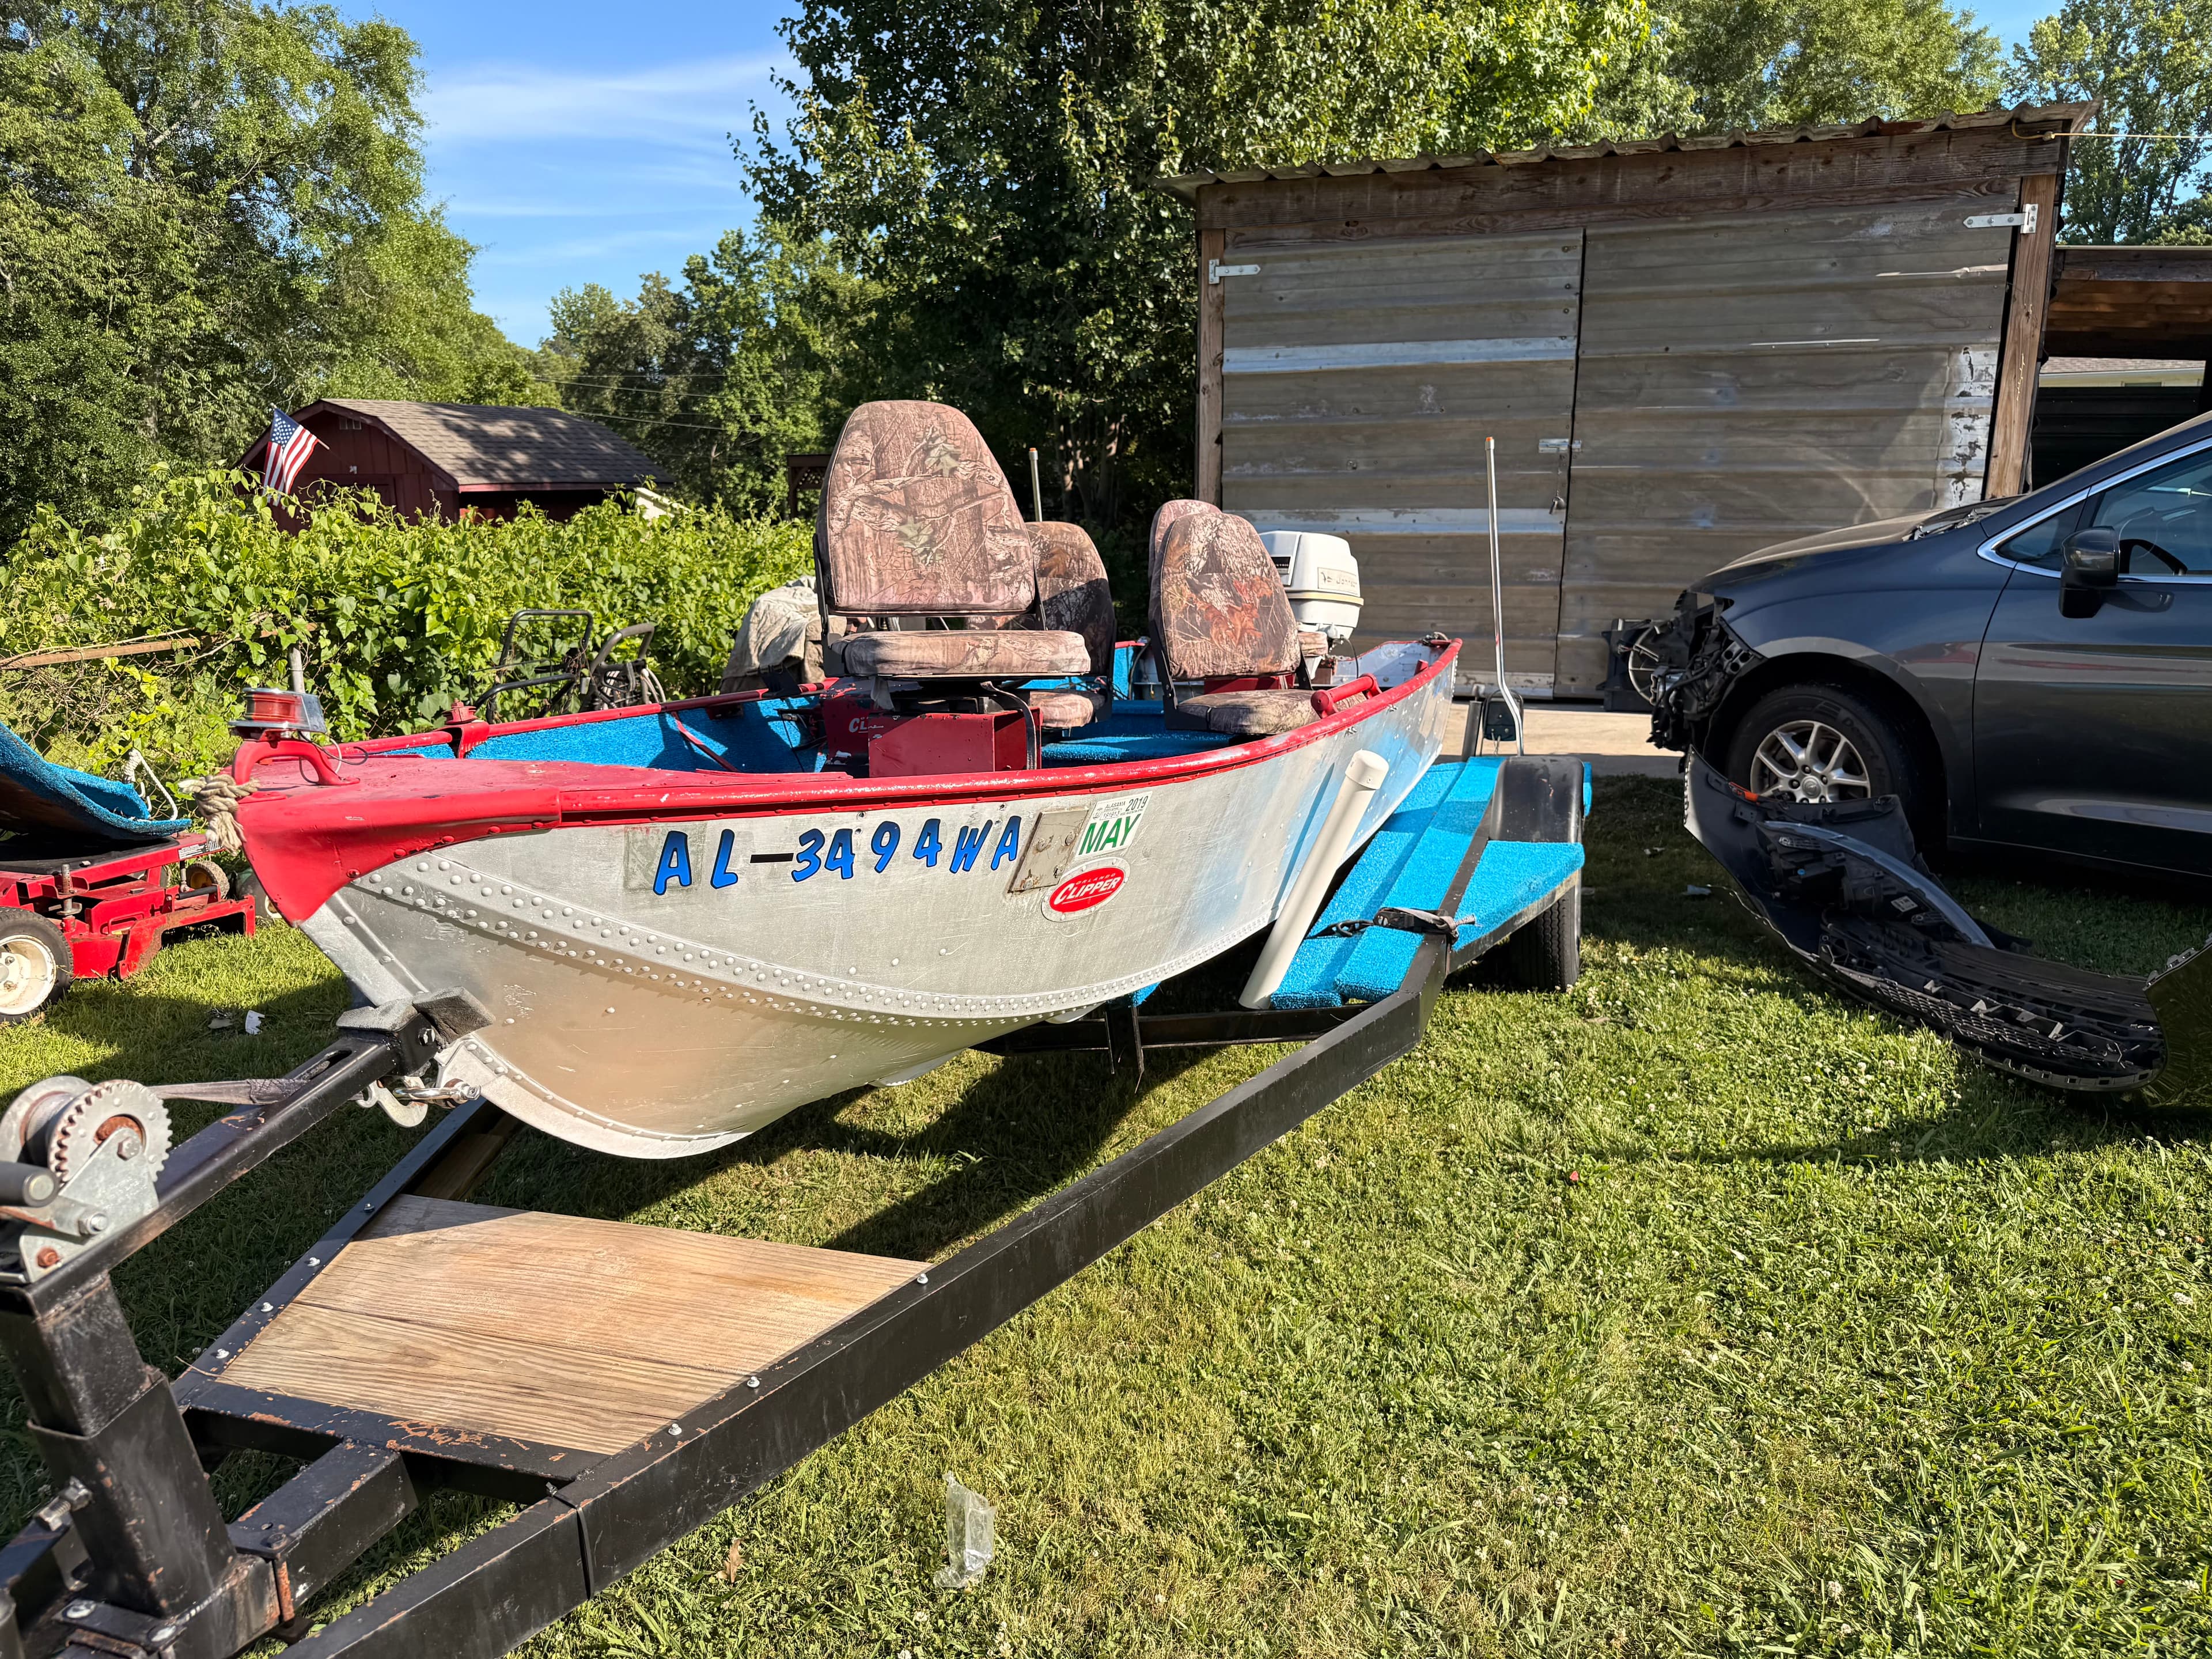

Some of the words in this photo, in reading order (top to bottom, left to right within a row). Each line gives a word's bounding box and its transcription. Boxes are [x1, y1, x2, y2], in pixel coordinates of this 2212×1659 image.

[1126, 796, 1149, 812] 2019
[1078, 813, 1142, 855] MAY
[1075, 873, 1116, 885] ORLANDO
[1054, 877, 1122, 906] CLIPPER
